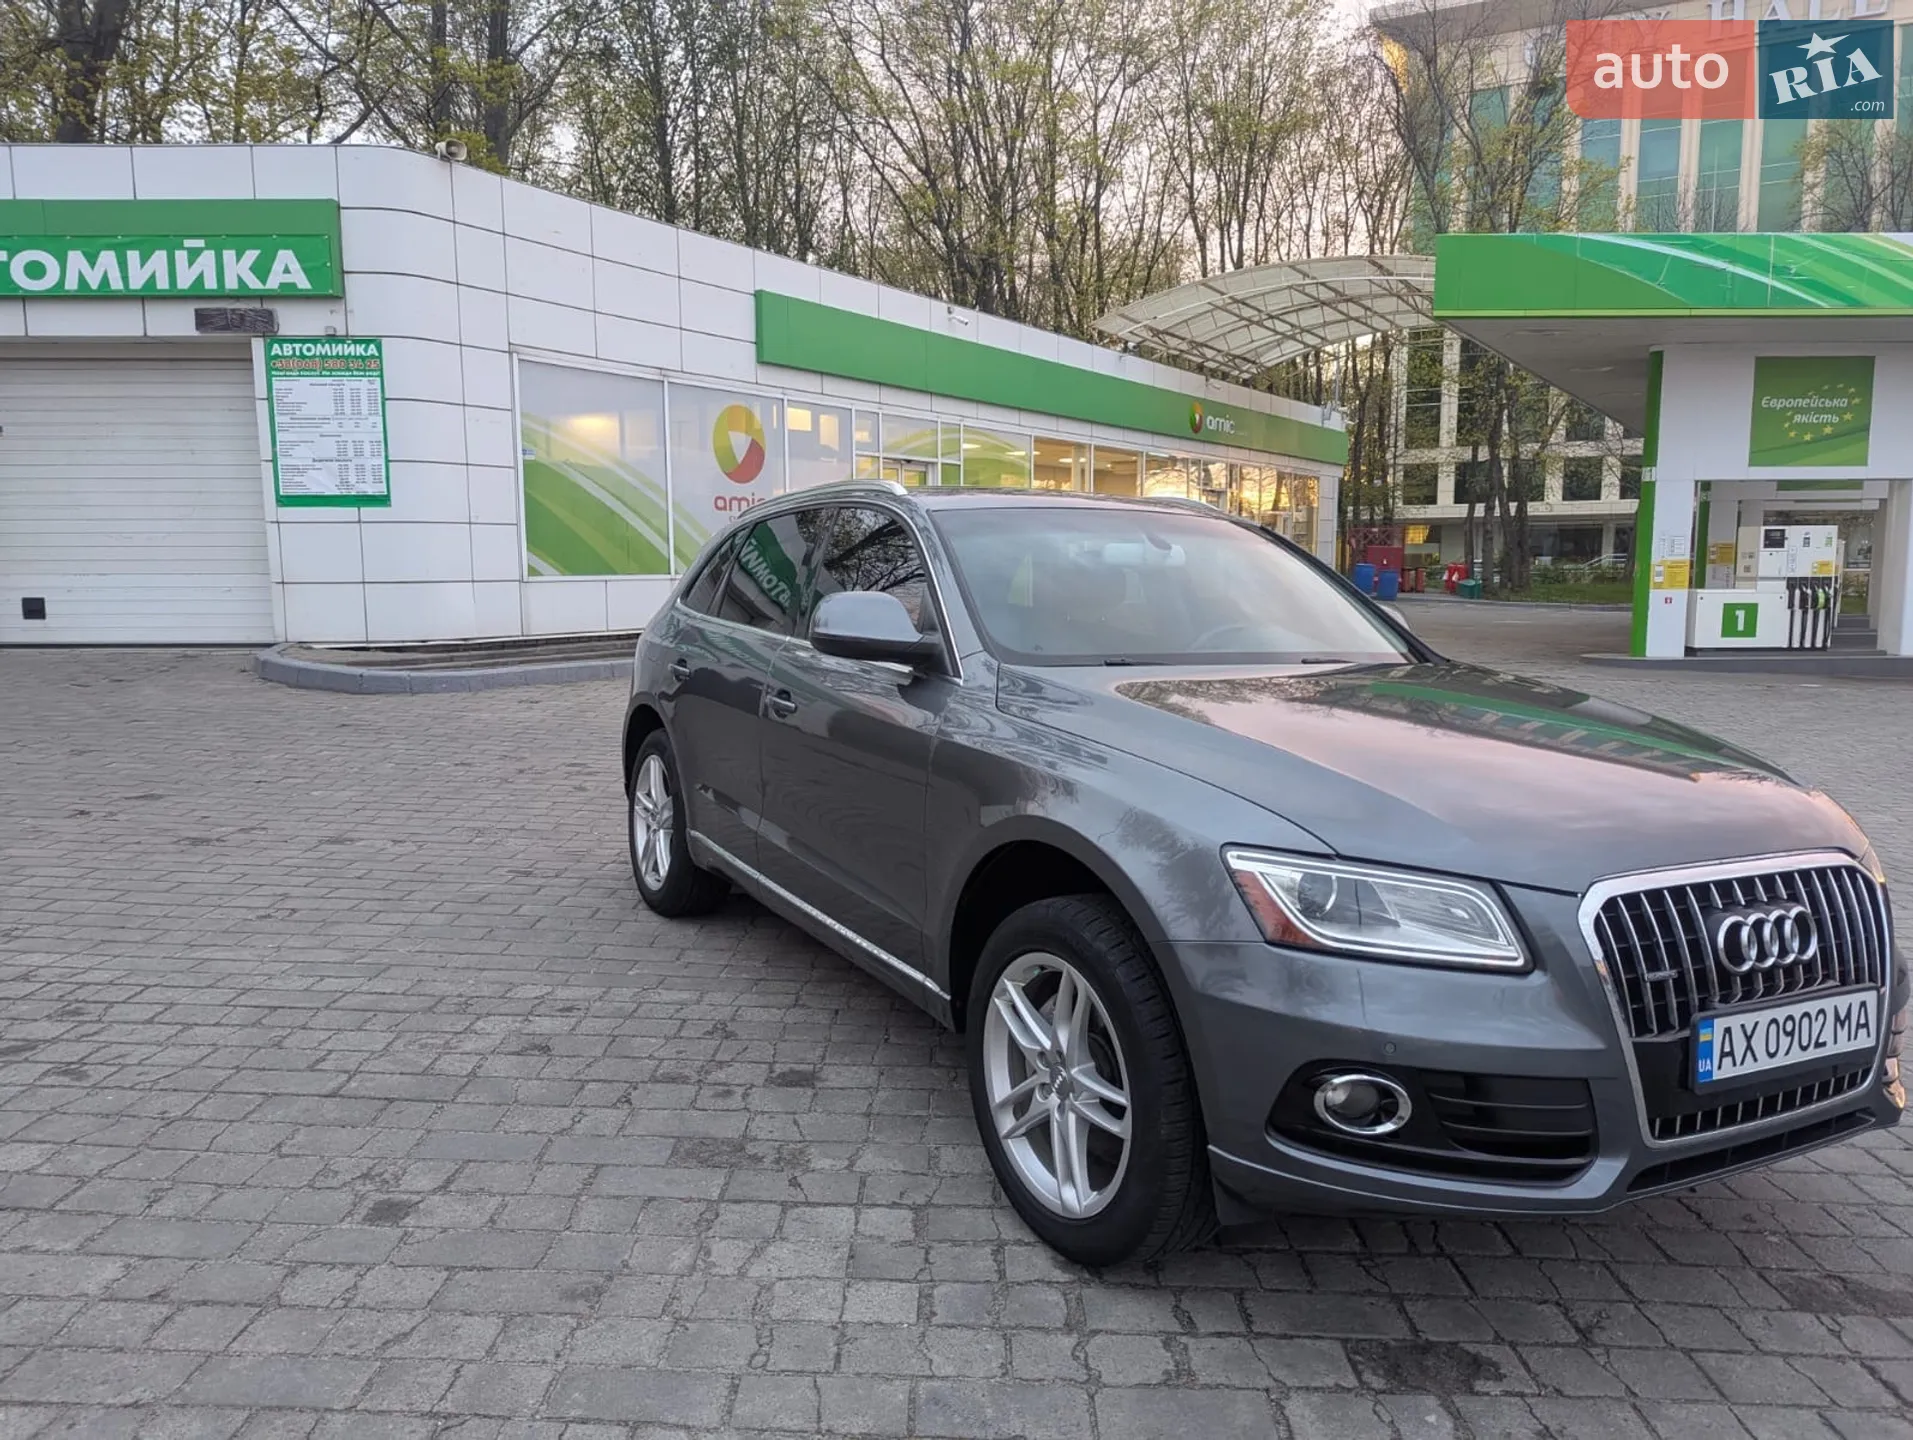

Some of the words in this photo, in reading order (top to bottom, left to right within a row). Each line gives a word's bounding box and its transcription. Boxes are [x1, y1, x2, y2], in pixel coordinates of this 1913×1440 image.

[0, 239, 313, 290] ОМИЙКА
[271, 341, 379, 356] АВТОМИЙКА
[1761, 395, 1848, 410] Європейська
[1207, 414, 1235, 434] amic
[1792, 411, 1839, 423] якість
[714, 492, 766, 512] ami
[1735, 609, 1745, 631] 1
[1717, 1020, 1759, 1070] AX
[1765, 1007, 1827, 1058] 0902
[1833, 1000, 1871, 1045] MA
[1698, 1060, 1712, 1072] UA
